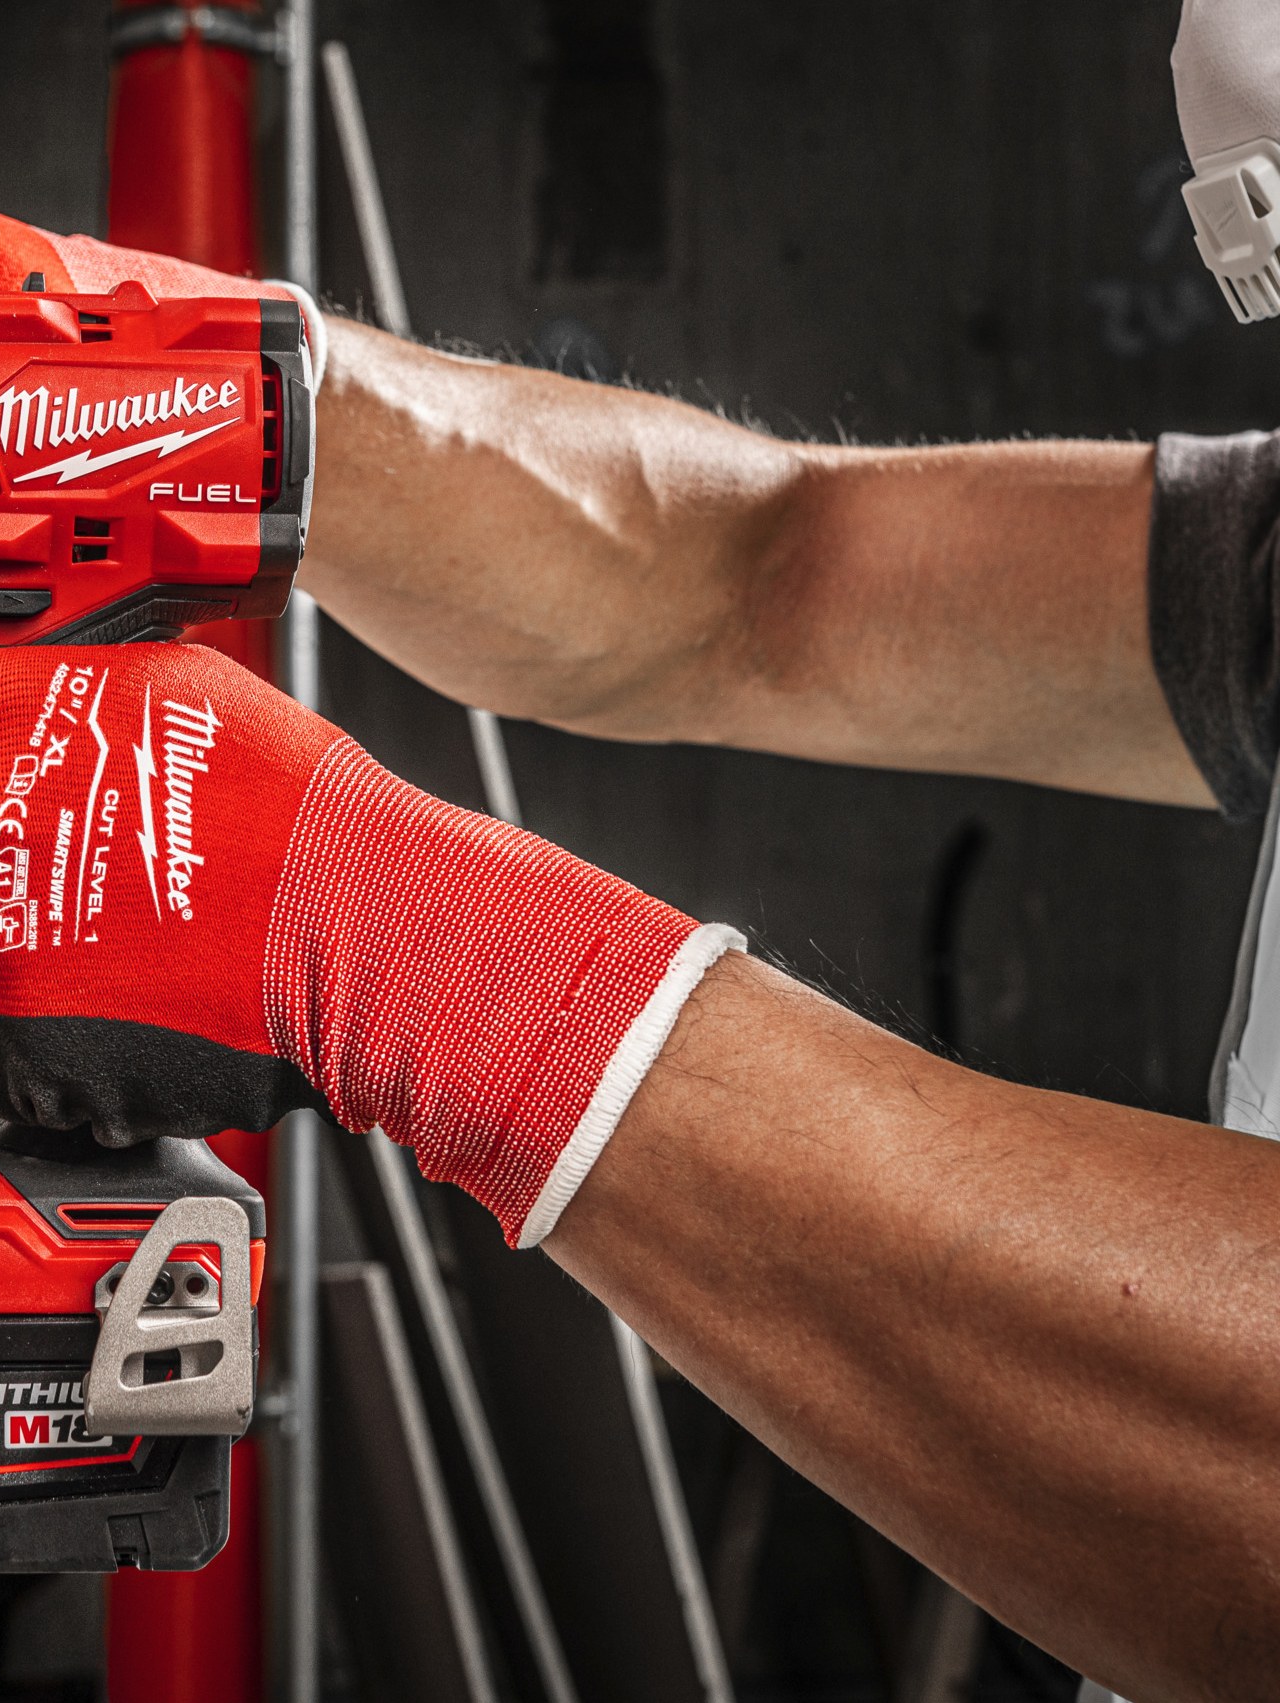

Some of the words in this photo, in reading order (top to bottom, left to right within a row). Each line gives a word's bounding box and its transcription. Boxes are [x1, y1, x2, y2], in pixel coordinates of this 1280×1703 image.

[149, 482, 257, 503] FUEL
[39, 733, 72, 777] XL
[97, 788, 120, 838] CUT
[16, 866, 25, 878] CUT
[15, 878, 25, 897] LEVEL
[86, 845, 111, 922] LEVEL
[84, 931, 99, 944] 1
